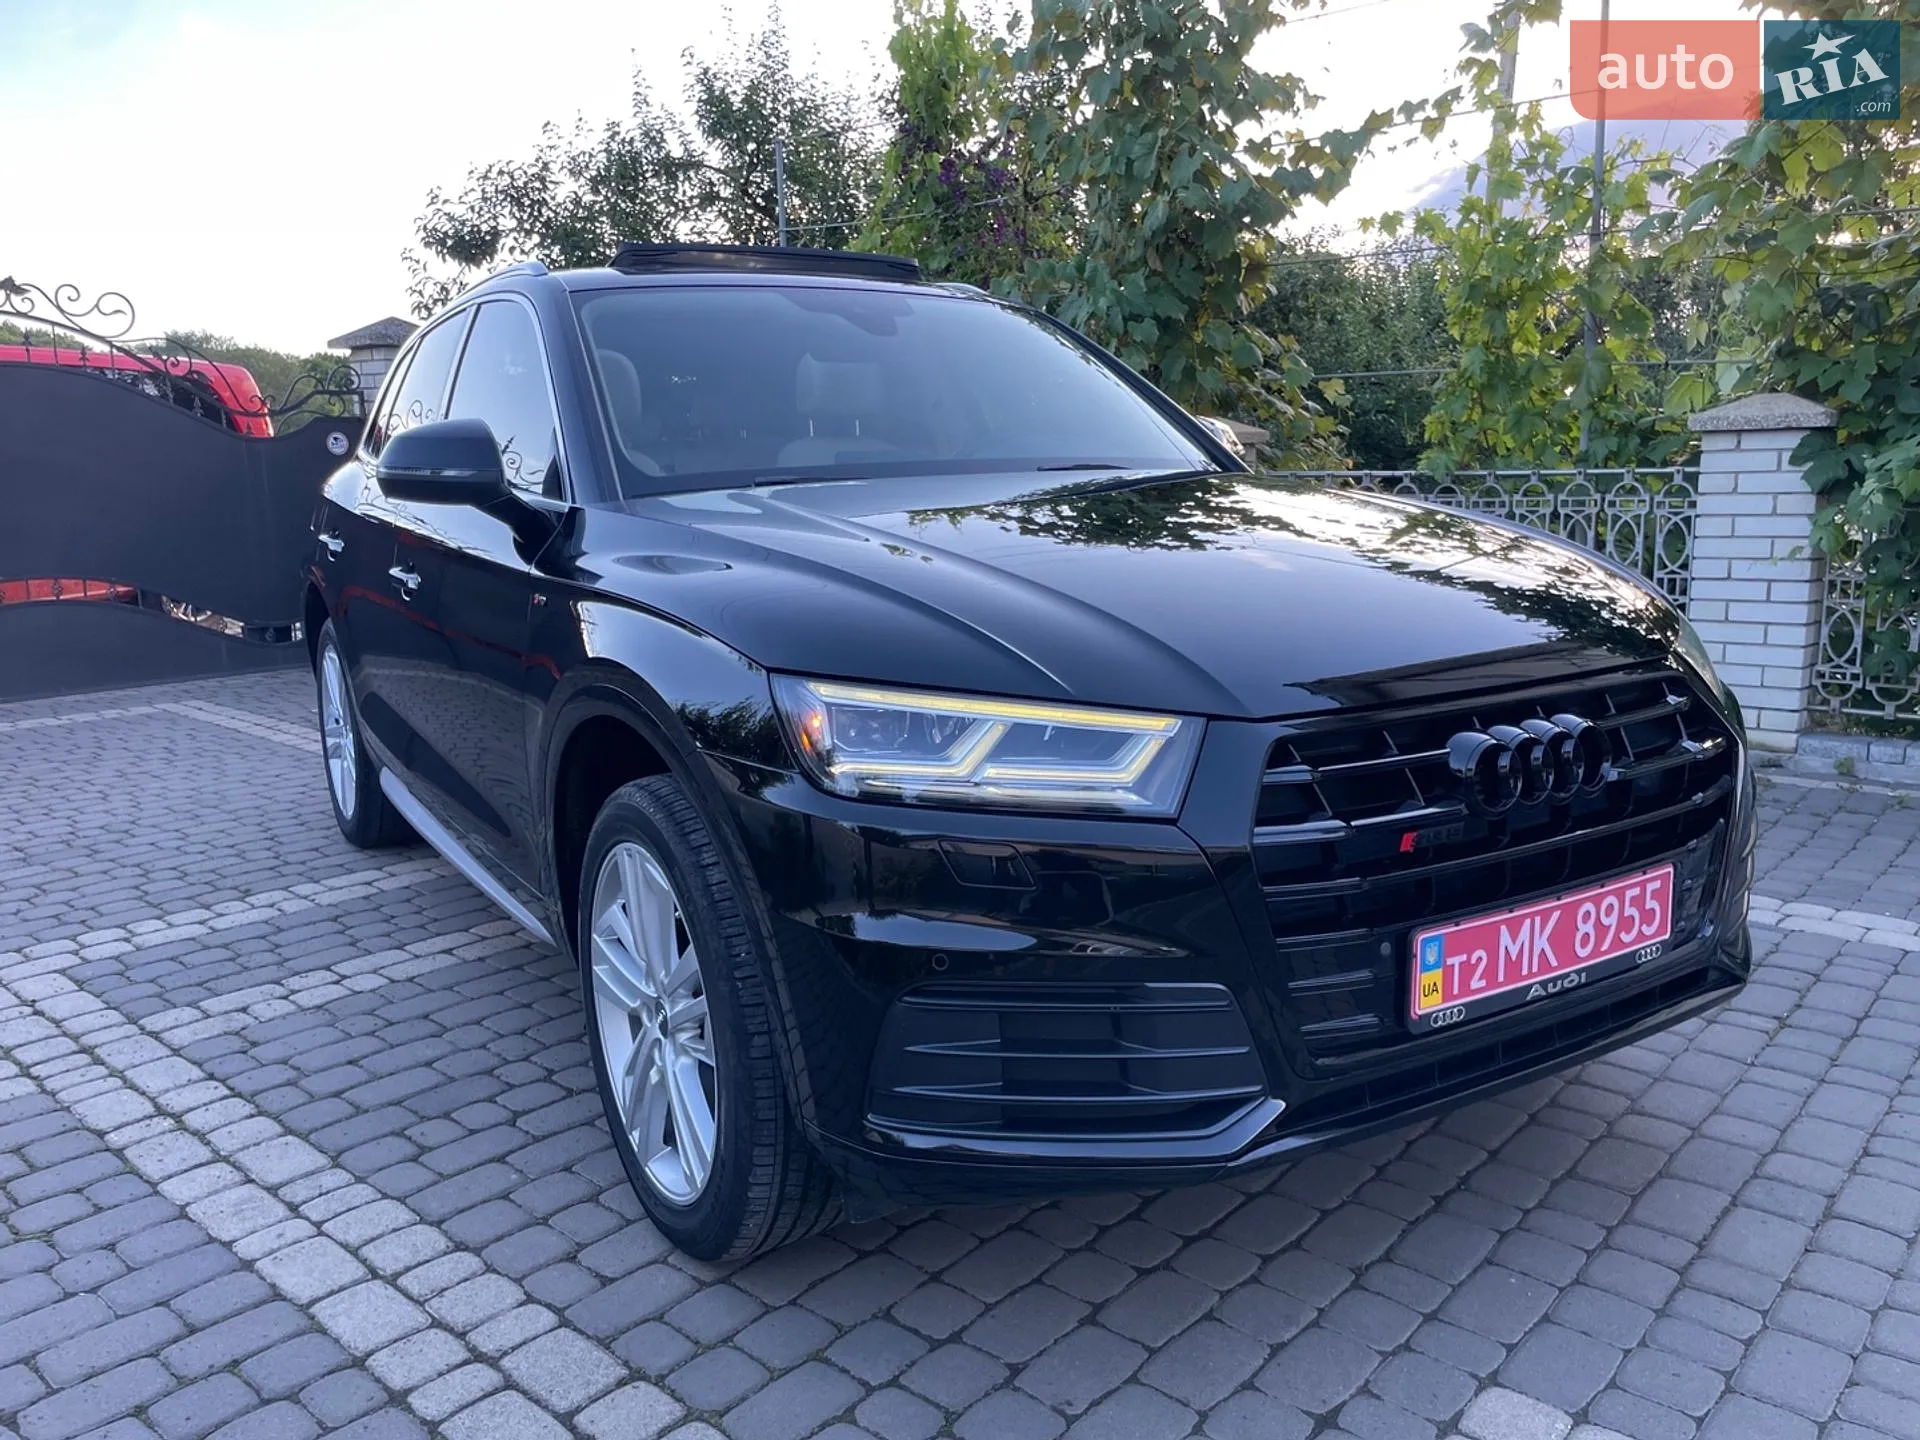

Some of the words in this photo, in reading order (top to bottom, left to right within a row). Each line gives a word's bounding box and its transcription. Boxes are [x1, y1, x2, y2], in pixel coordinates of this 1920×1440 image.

[1446, 949, 1488, 995] T2
[1497, 910, 1562, 982] MK
[1574, 880, 1662, 958] 8955
[1422, 981, 1440, 998] UA
[1525, 972, 1587, 1000] Audi
